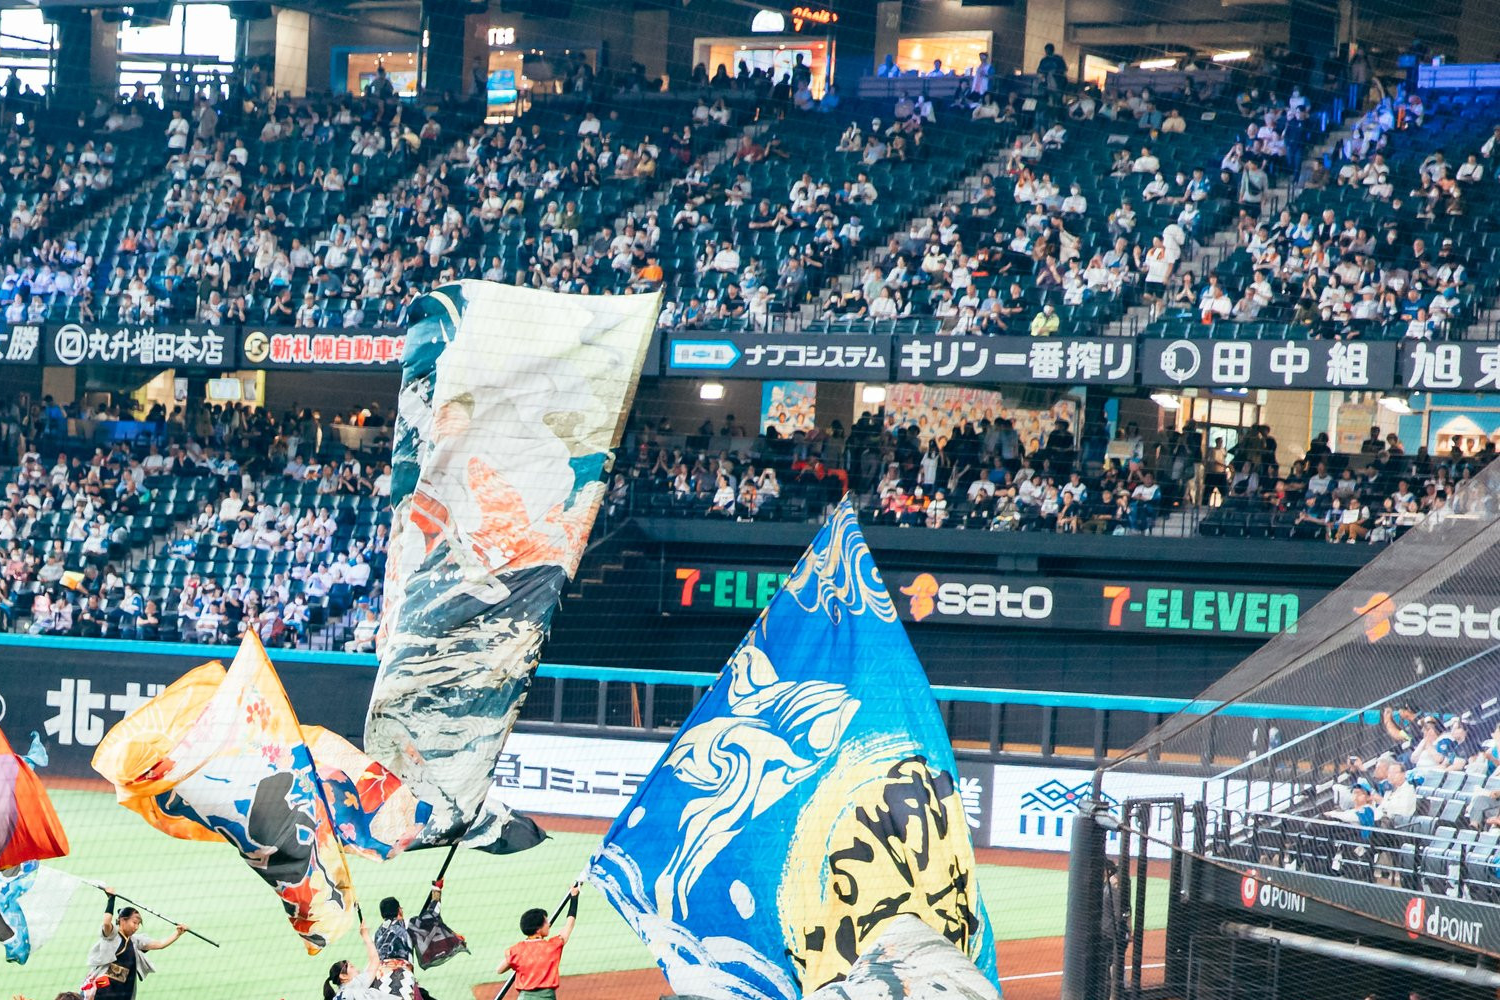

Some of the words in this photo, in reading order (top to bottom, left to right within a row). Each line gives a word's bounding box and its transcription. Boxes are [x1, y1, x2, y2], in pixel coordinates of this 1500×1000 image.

[88, 327, 225, 365] 丸升増田本店
[900, 340, 1133, 380] キリン一番搾り
[1212, 340, 1369, 385] 田中組
[936, 582, 1053, 619] sato
